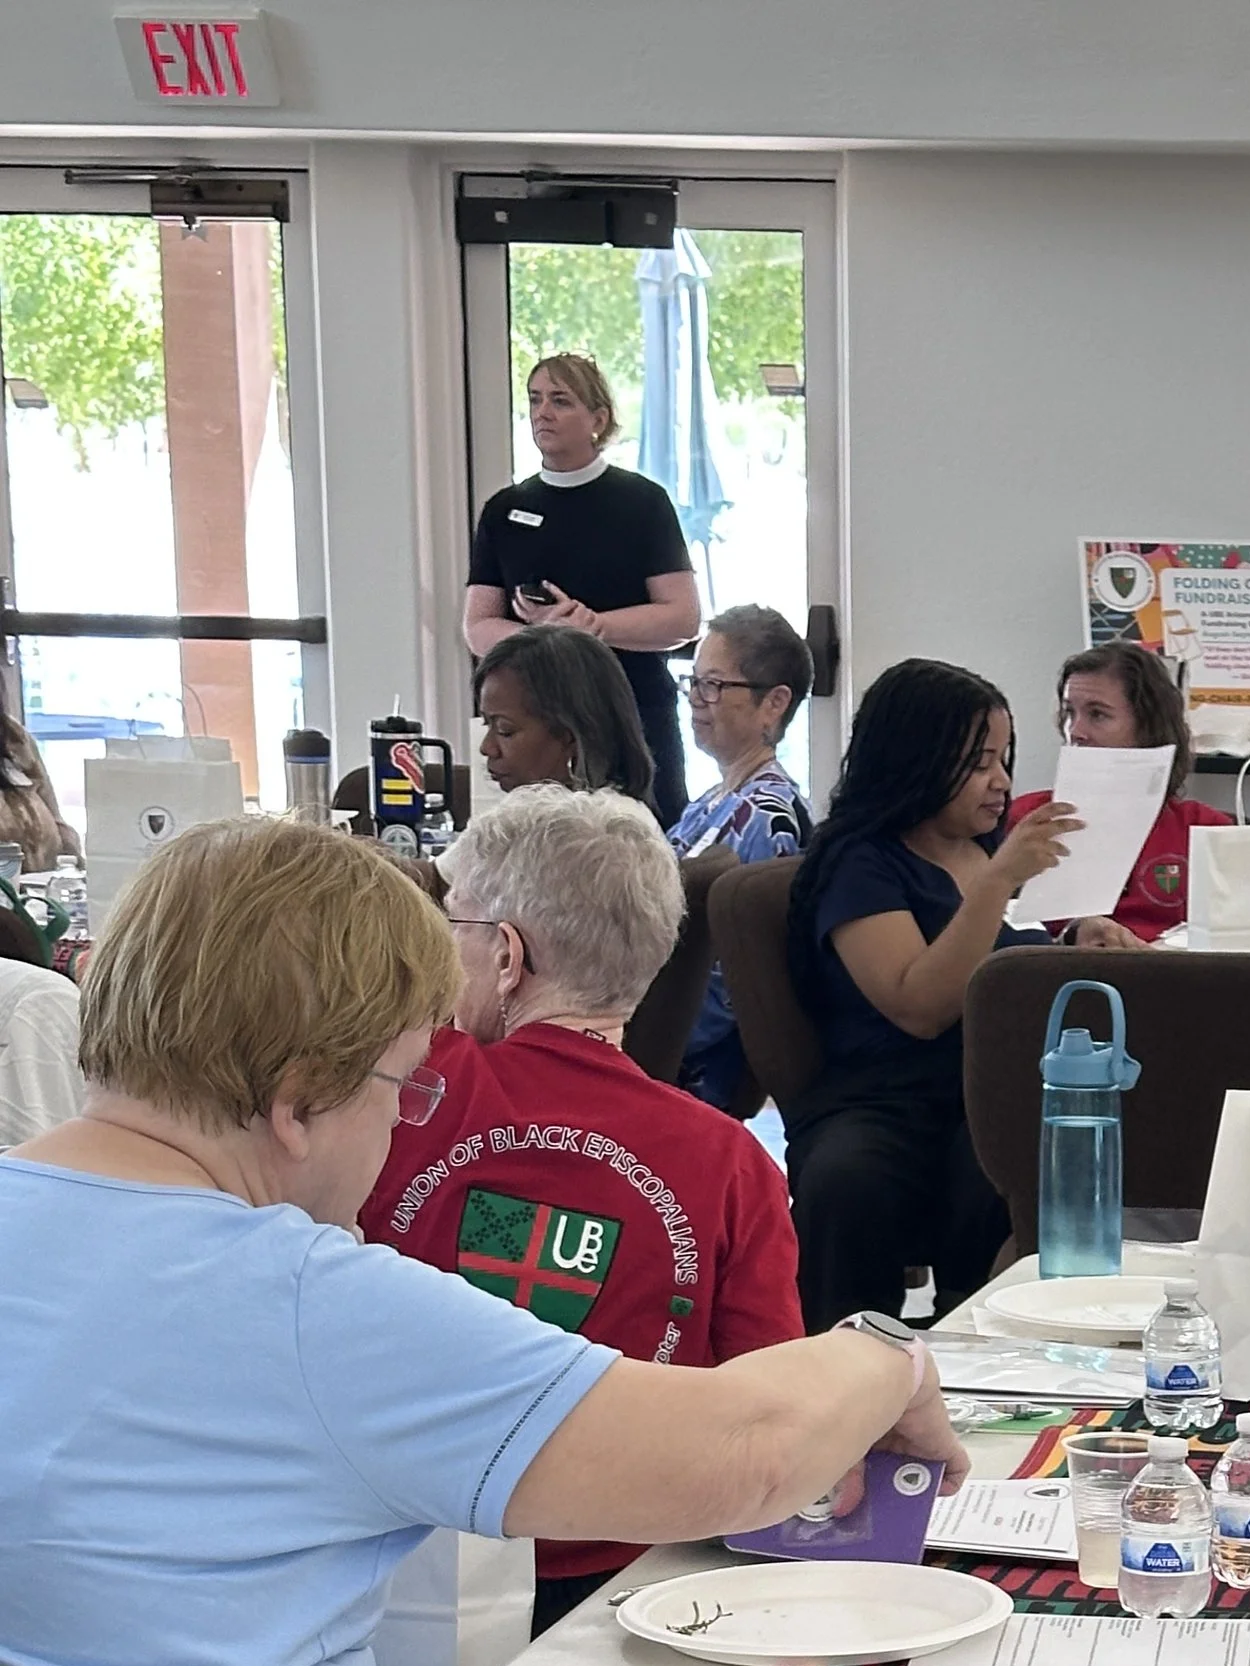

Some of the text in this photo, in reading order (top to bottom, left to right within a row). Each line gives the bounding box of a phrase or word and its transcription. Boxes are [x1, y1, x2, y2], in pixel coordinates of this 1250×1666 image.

[142, 23, 247, 96] EXIT
[1173, 577, 1240, 590] FOLDING
[390, 1124, 698, 1286] UNION OF BLACK EPISCOPALIANS
[1145, 1557, 1181, 1567] WATER
